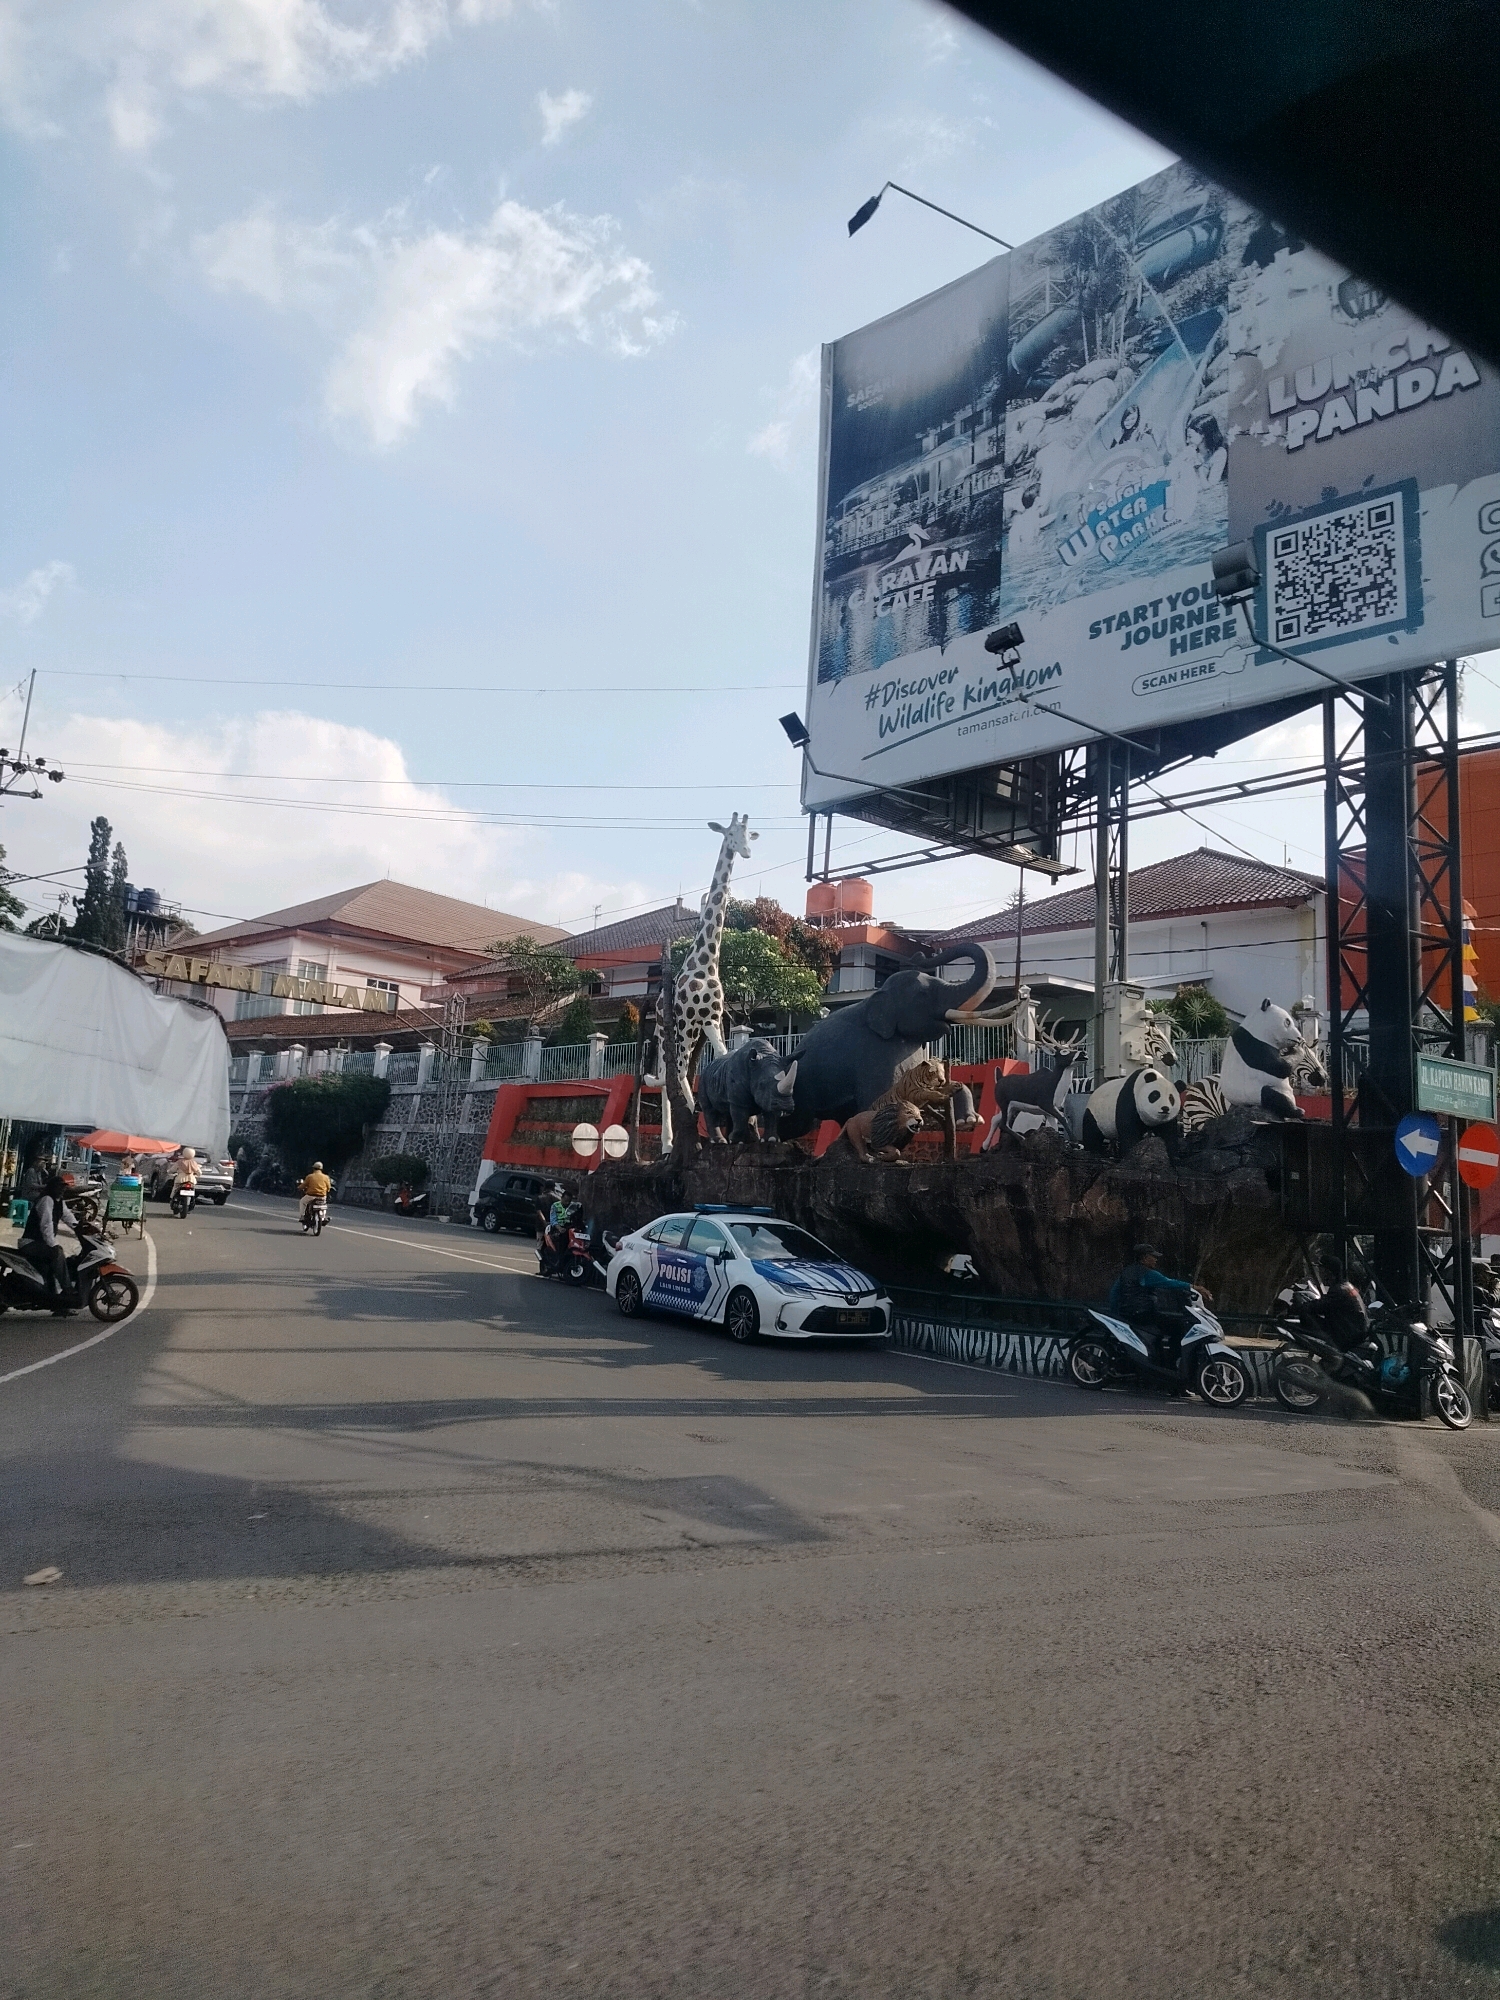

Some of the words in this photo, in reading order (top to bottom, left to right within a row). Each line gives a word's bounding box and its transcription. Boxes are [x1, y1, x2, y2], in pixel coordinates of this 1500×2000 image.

[1287, 351, 1481, 453] PANDA
[848, 550, 970, 610] CARAVAN
[876, 580, 937, 617] CAFE
[1089, 598, 1163, 640] START
[1121, 597, 1234, 651] JOURNEY
[1169, 618, 1237, 657] HERE
[864, 666, 960, 711] #Discover
[1141, 671, 1178, 690] SCAN
[1180, 662, 1216, 681] HERE
[879, 690, 956, 738] Wildlife
[957, 700, 1062, 737] tamansafari.com
[144, 950, 263, 992] SAFARI
[272, 973, 389, 1013] MALAM
[659, 1263, 692, 1284] POLISI
